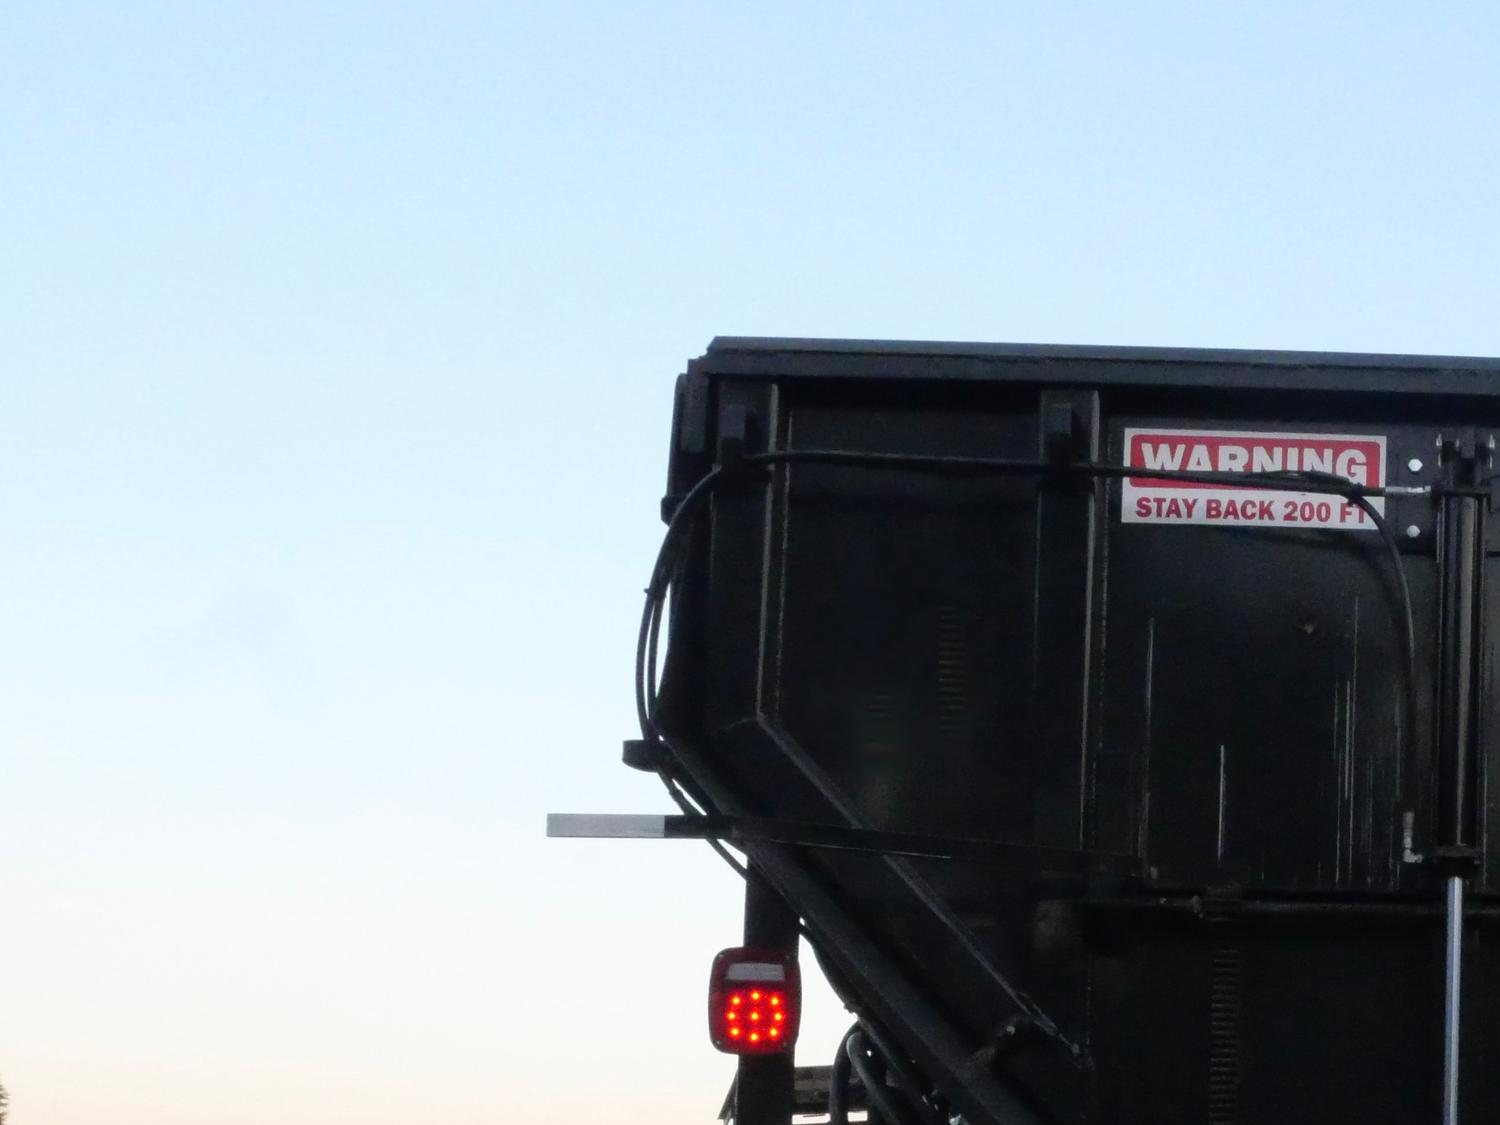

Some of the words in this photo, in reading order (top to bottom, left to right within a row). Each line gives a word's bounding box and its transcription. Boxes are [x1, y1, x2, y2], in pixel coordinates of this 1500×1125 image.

[1141, 443, 1367, 486] WARNING
[1136, 497, 1198, 518] STAY
[1205, 499, 1275, 522] BACK
[1283, 501, 1331, 523] 200
